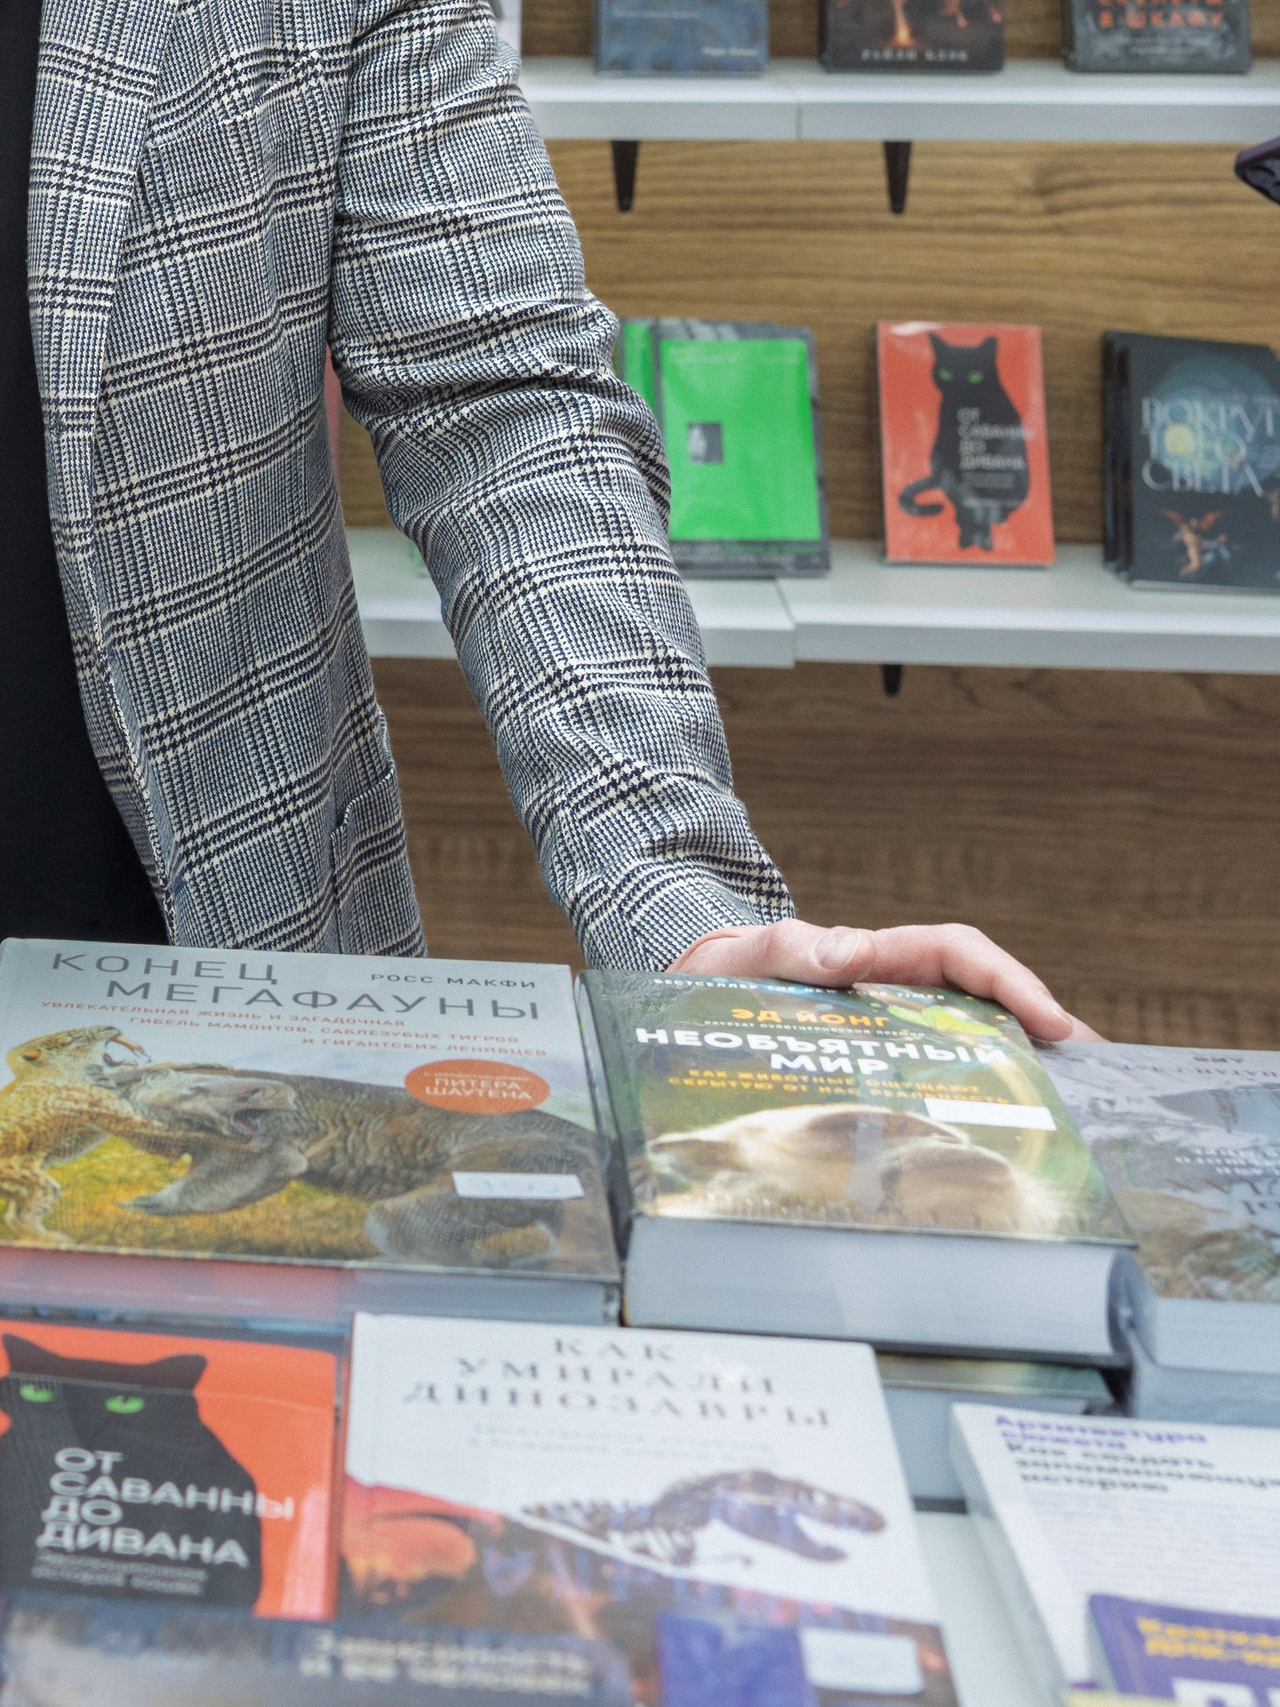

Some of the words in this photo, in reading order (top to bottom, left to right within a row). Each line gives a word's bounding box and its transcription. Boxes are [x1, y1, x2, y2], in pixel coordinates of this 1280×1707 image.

[1124, 9, 1224, 30] ШКАФУ
[52, 952, 279, 985] КОНЕЦ
[371, 973, 434, 984] РОСС
[446, 977, 536, 989] МАКФИ
[654, 978, 758, 991] БЕСТСЕЛЛЕР
[107, 980, 539, 1020] МЕГАФАУНЫ
[40, 1001, 191, 1016] УВЛЕКАТЕЛЬНАЯ
[197, 1009, 262, 1020] ЖИЗНЬ
[289, 1014, 405, 1027] ЗАГАДОЧНАЯ
[731, 1008, 782, 1024] ЭД
[795, 1009, 890, 1028] ЙОНГ
[129, 1017, 200, 1028] ГИБЕЛЬ
[207, 1021, 313, 1035] МАМОНТОВ,
[320, 1027, 440, 1041] САБЛЕЗУБЫХ
[449, 1033, 519, 1044] ТИГРОВ
[301, 1037, 314, 1045] И
[322, 1038, 438, 1052] ГИГАНТСКИХ
[446, 1044, 548, 1057] ЛЕНИВЦЕВ
[635, 1027, 1010, 1066] НЕОБЪЯТНЫЙ
[770, 1053, 890, 1076] МИР
[425, 1087, 532, 1102] ШАУТЕНА
[434, 1076, 523, 1092] ПИТЕРА
[668, 1077, 773, 1091] СКРЫТУЮ
[782, 1082, 810, 1093] ОТ
[864, 1088, 1010, 1105] РЕАЛЬНОСТЬ
[689, 1069, 735, 1079] КАК
[738, 1071, 855, 1087] ЖИВОТНЫЕ
[864, 1078, 980, 1095] ОЩУЩАЮТ
[553, 1337, 675, 1362] КАК
[457, 1356, 776, 1396] УМИРАЛИ
[403, 1381, 831, 1429] ДИНОЗАВРЫ
[54, 1447, 124, 1475] ОТ
[49, 1471, 295, 1522] САВАННЫ
[40, 1495, 124, 1526] ДО
[35, 1521, 249, 1569] ДИВАНА
